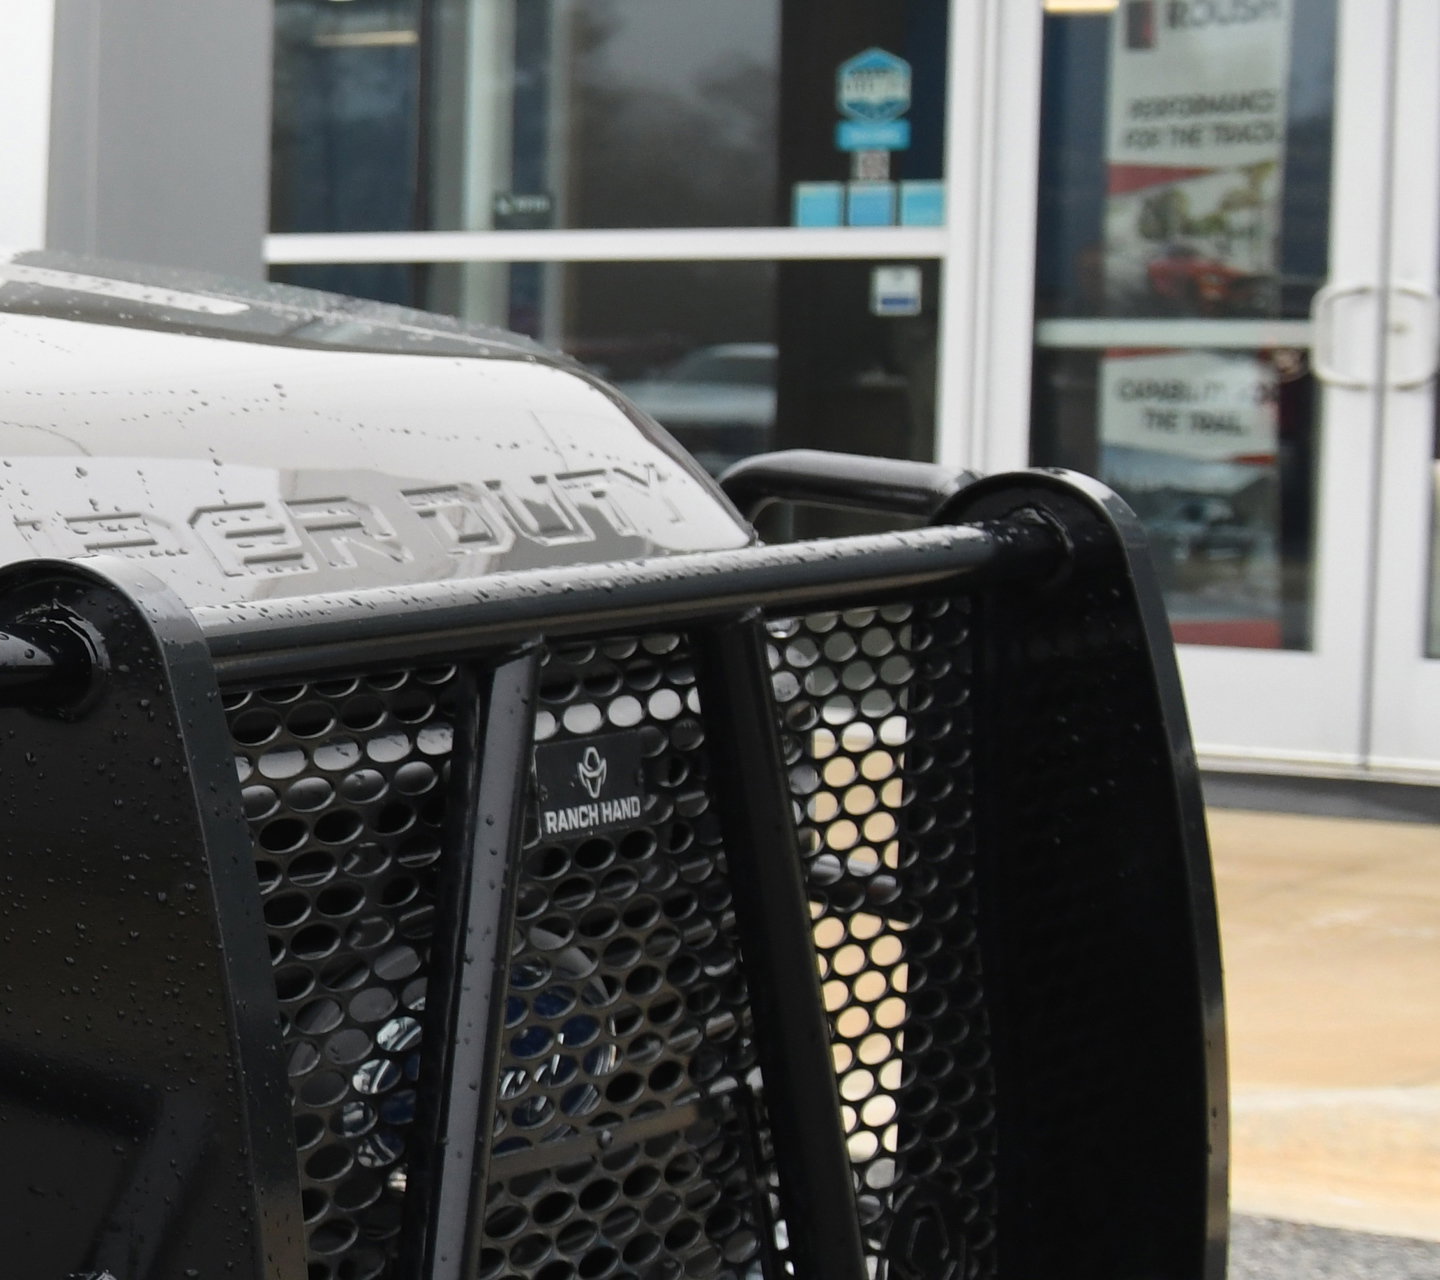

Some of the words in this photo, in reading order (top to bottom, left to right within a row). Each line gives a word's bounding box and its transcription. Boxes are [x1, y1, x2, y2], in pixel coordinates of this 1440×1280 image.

[404, 463, 687, 556] DUTY
[543, 801, 600, 835] RANCH
[600, 795, 642, 825] HAND
